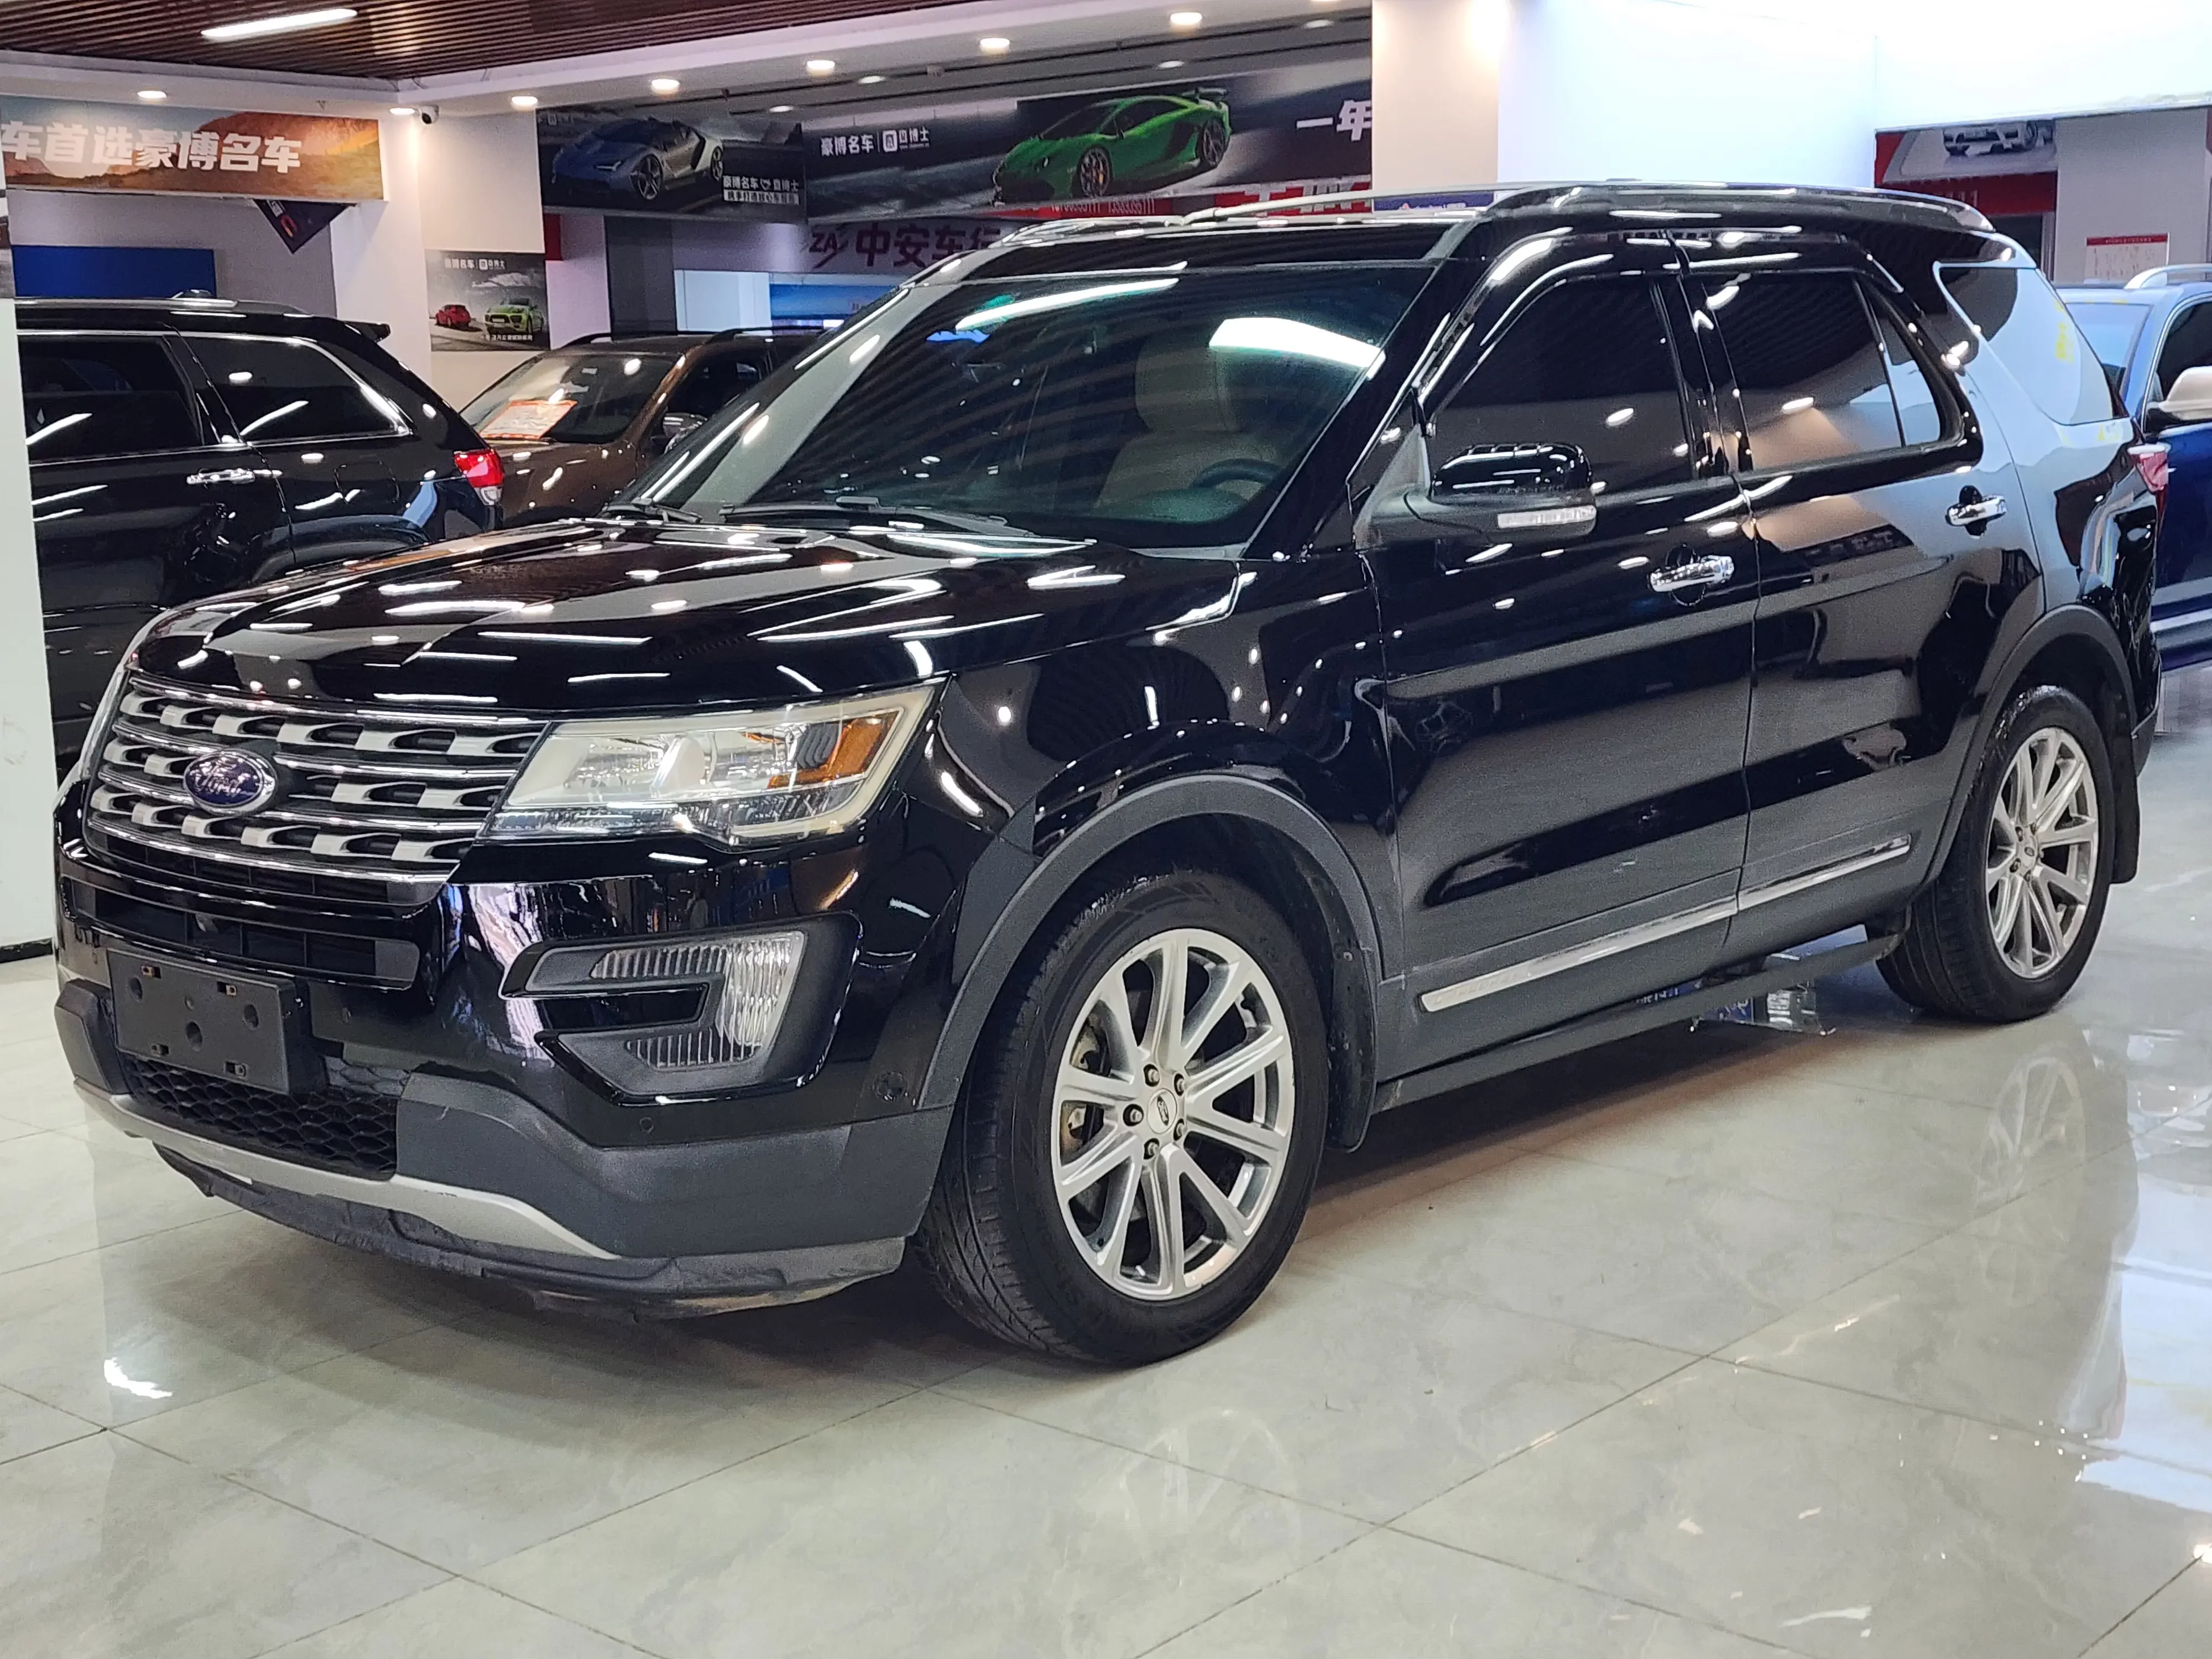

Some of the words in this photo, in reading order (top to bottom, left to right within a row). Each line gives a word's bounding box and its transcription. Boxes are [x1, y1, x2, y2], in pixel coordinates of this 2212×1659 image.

[1, 120, 302, 174] 车首选豪博名车
[190, 760, 255, 797] Ford
